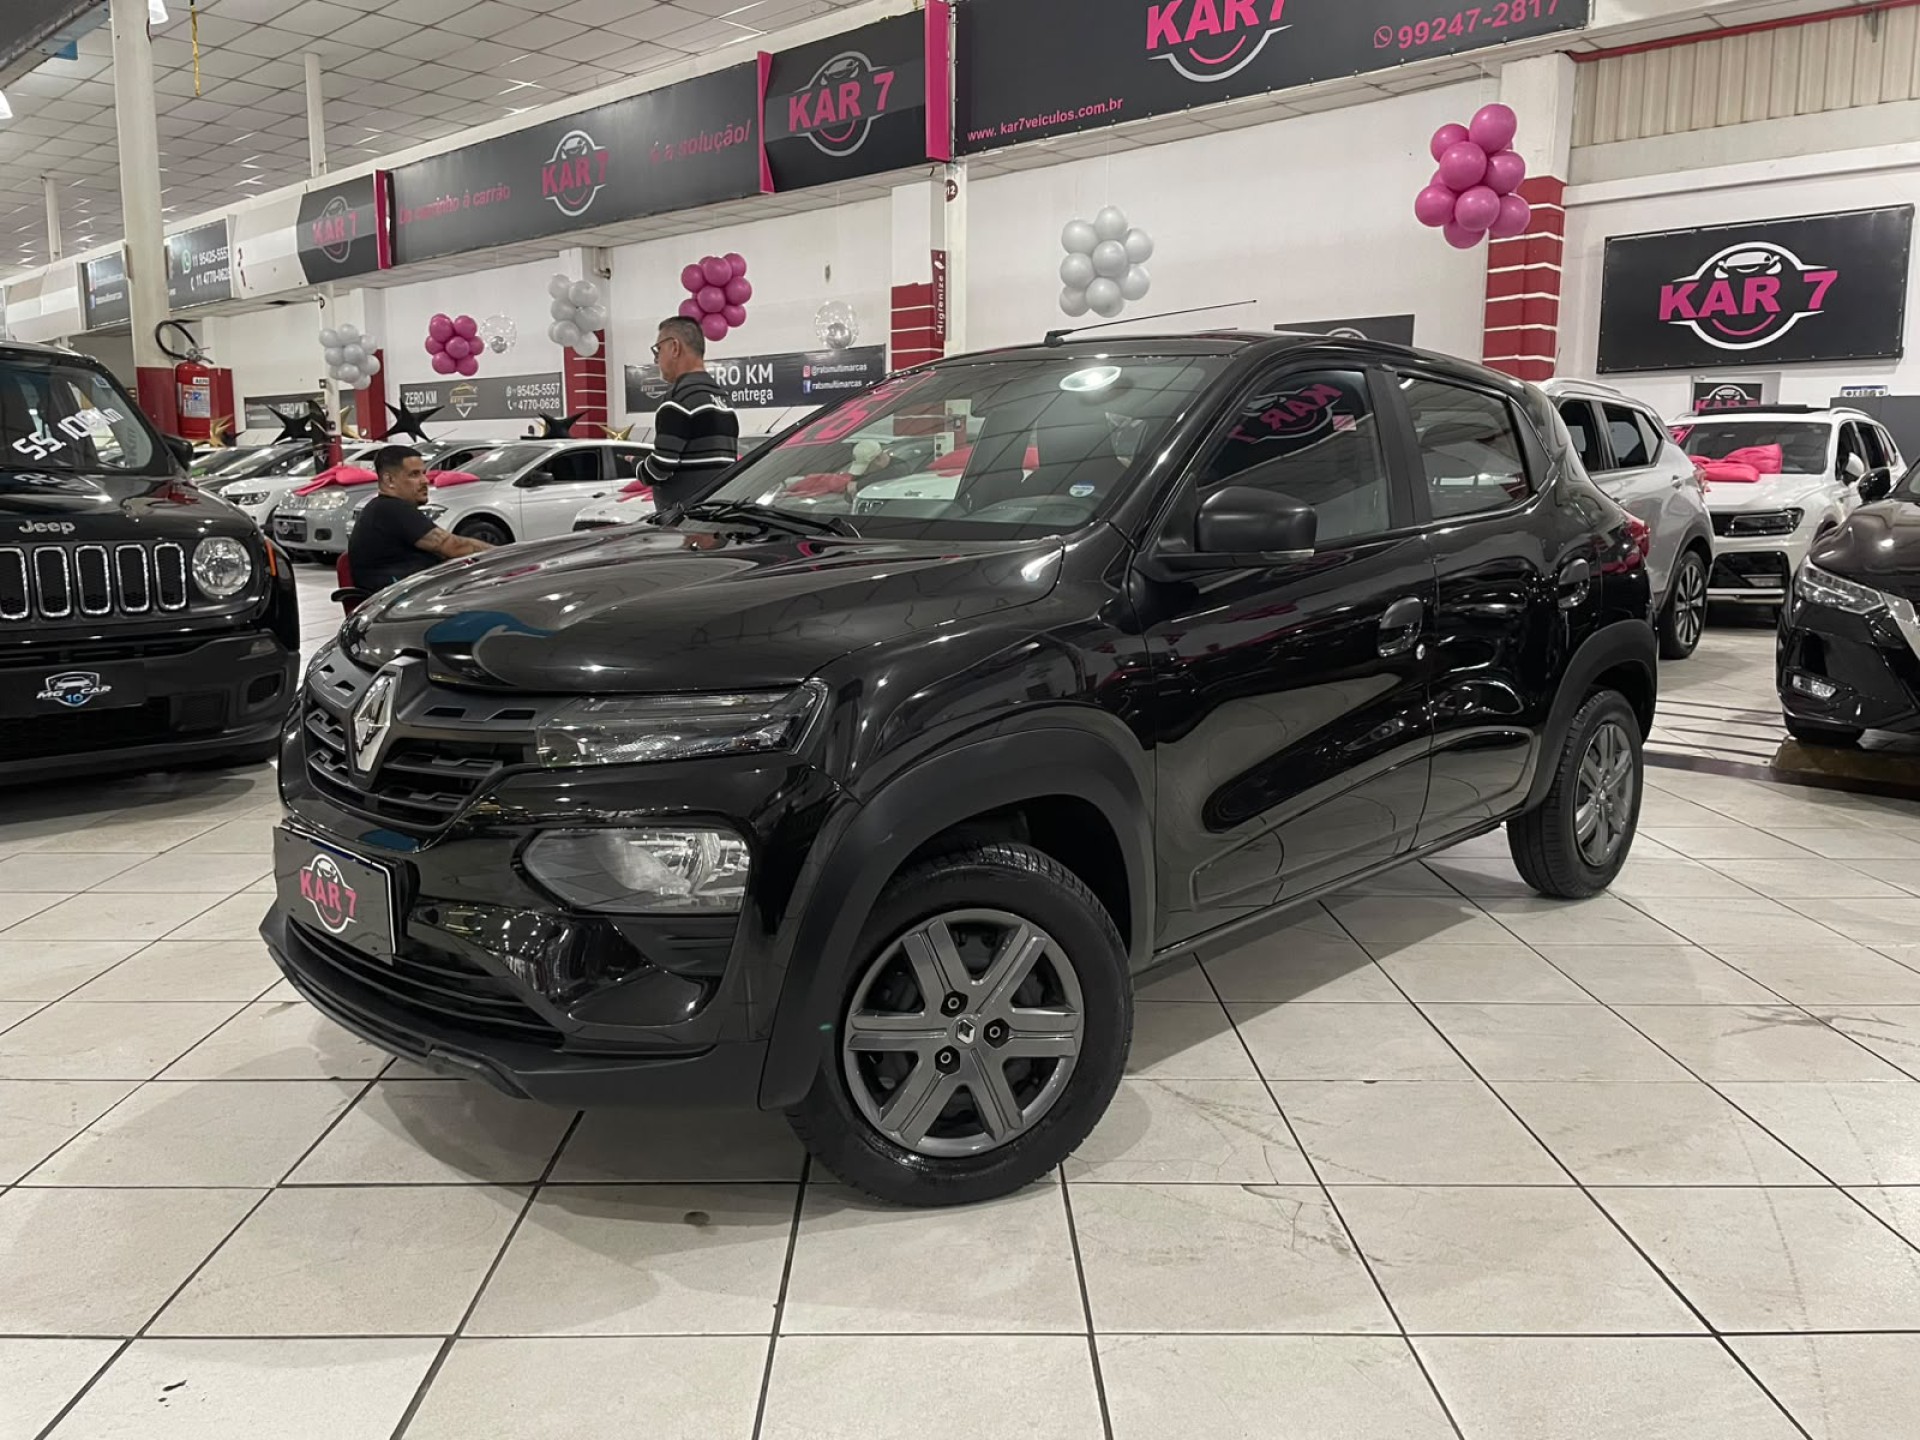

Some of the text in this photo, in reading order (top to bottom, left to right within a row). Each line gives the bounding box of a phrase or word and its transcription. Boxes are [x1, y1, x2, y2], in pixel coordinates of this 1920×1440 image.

[1146, 0, 1260, 49] KAR
[788, 71, 895, 133] KAR 7
[541, 151, 610, 197] KAR 7
[312, 212, 359, 244] KAR 7
[1658, 270, 1838, 320] KAR 7
[746, 363, 773, 385] KM
[404, 391, 425, 405] ZERO
[731, 387, 774, 405] entrega
[19, 520, 76, 534] Jeep
[66, 693, 83, 703] 10
[80, 685, 112, 695] CAR
[300, 869, 358, 918] KAR 7
